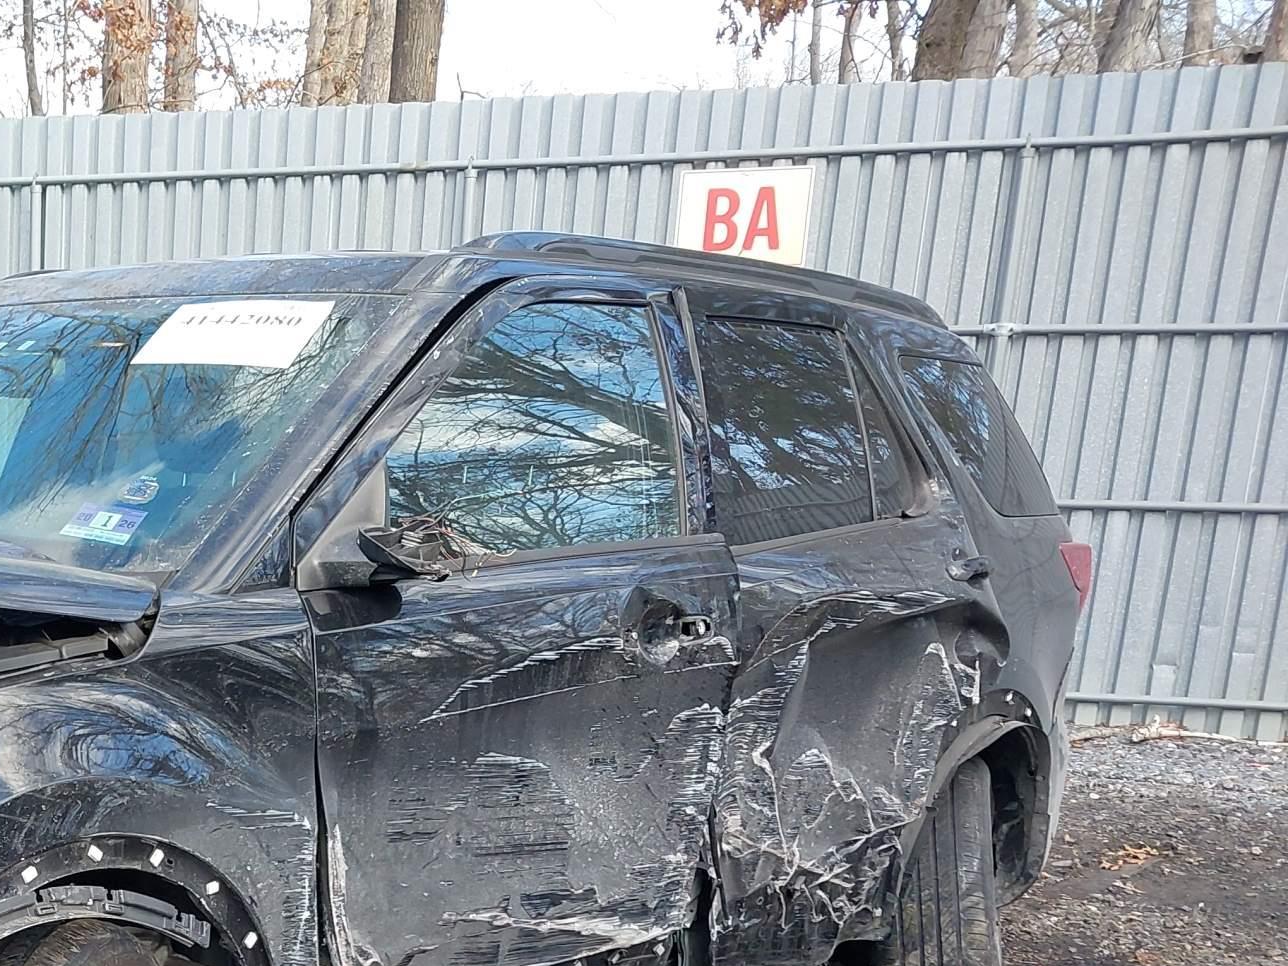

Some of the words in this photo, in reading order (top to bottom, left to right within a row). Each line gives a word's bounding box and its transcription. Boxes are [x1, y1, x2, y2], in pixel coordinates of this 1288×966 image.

[703, 186, 779, 251] BA
[102, 515, 114, 527] 1
[118, 519, 136, 529] 26
